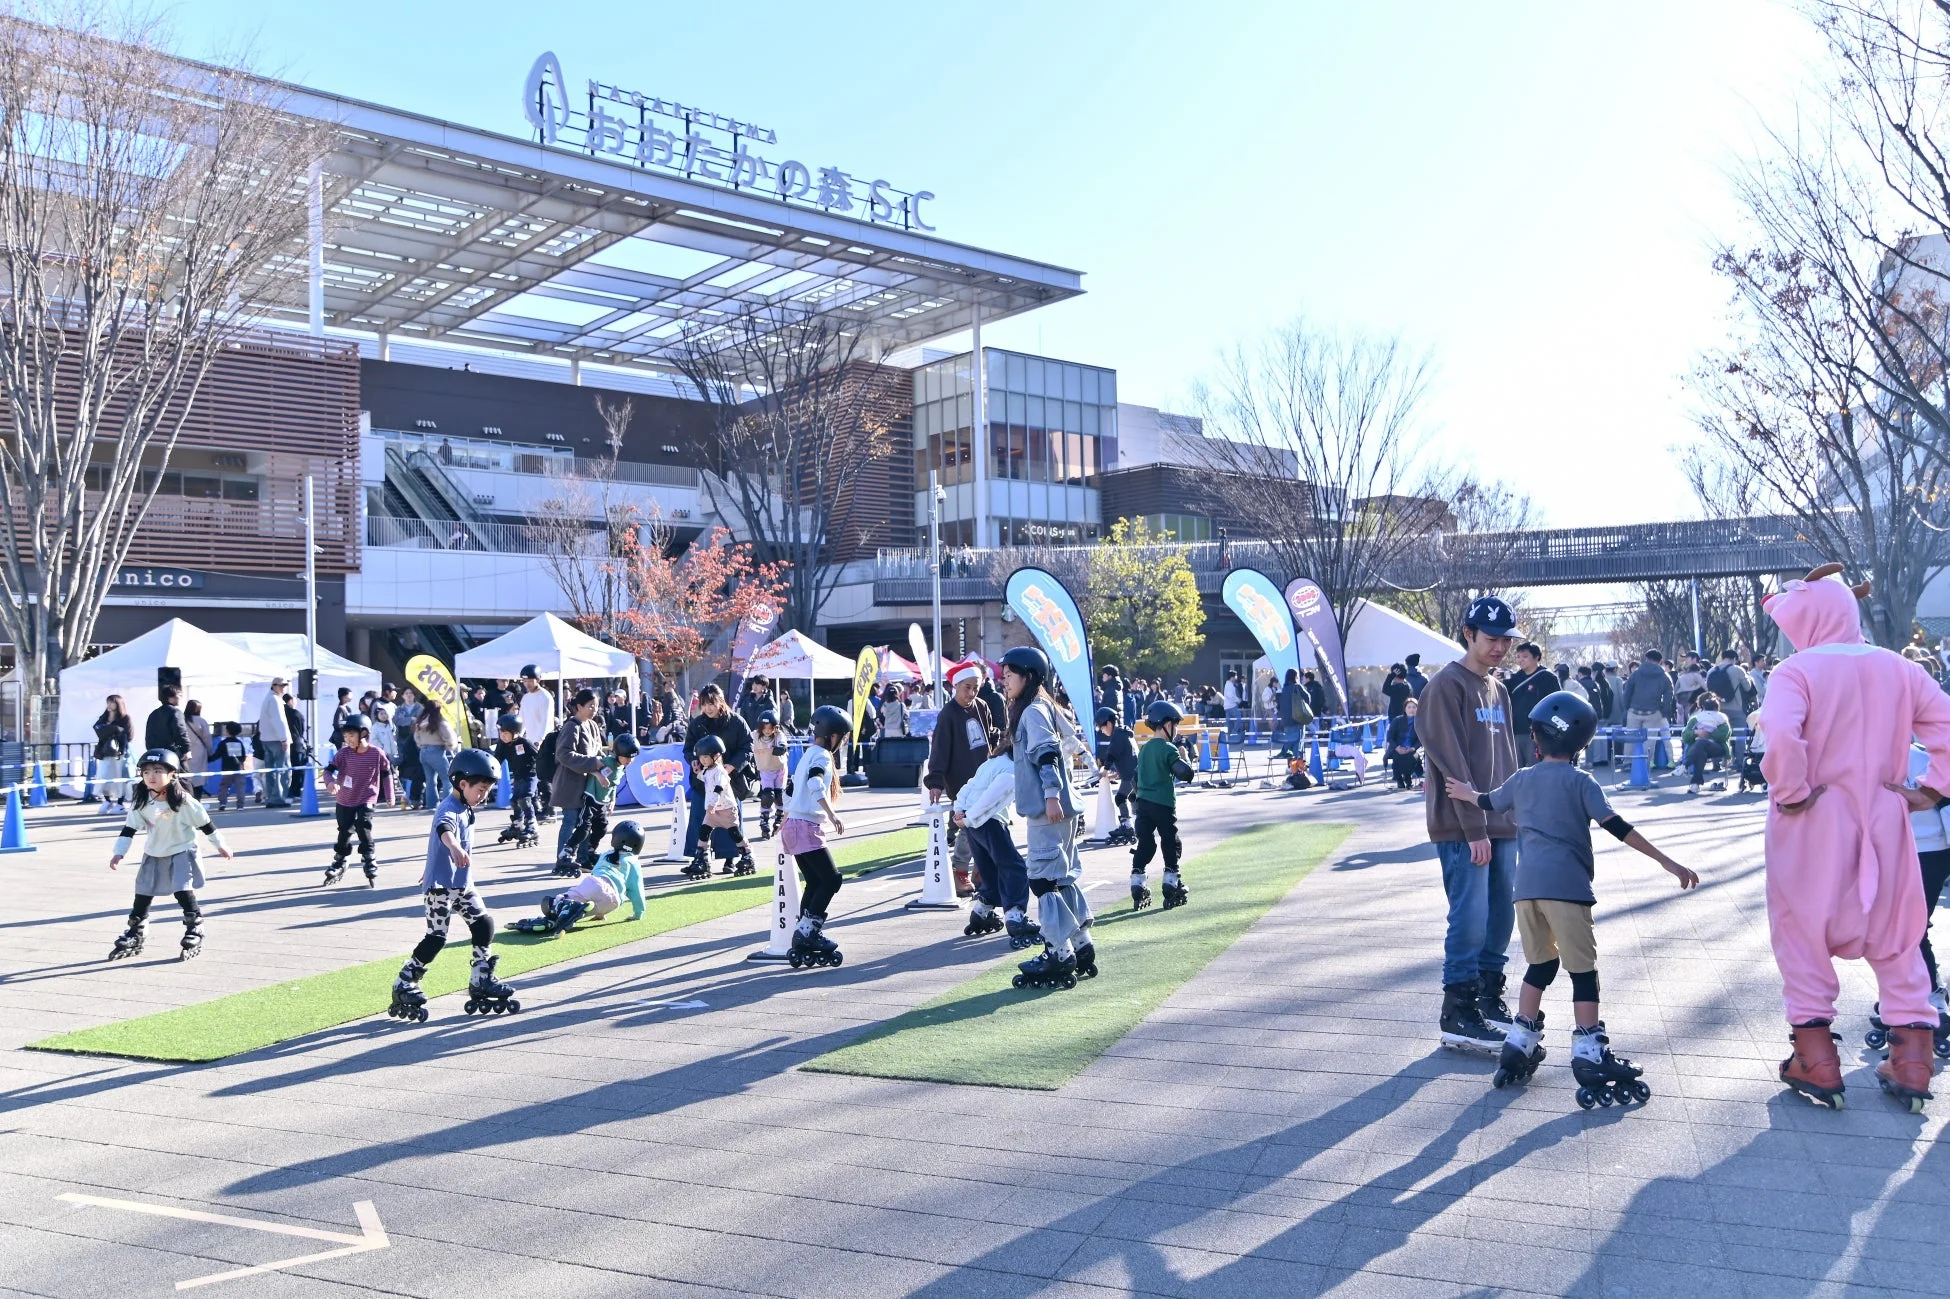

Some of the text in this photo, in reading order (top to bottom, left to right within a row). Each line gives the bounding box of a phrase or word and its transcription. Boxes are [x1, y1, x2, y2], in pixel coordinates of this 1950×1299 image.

[587, 79, 778, 145] NAGAREYAMA
[134, 599, 167, 607] unico
[933, 818, 941, 882] CLAPS
[778, 853, 786, 929] CLAPS
